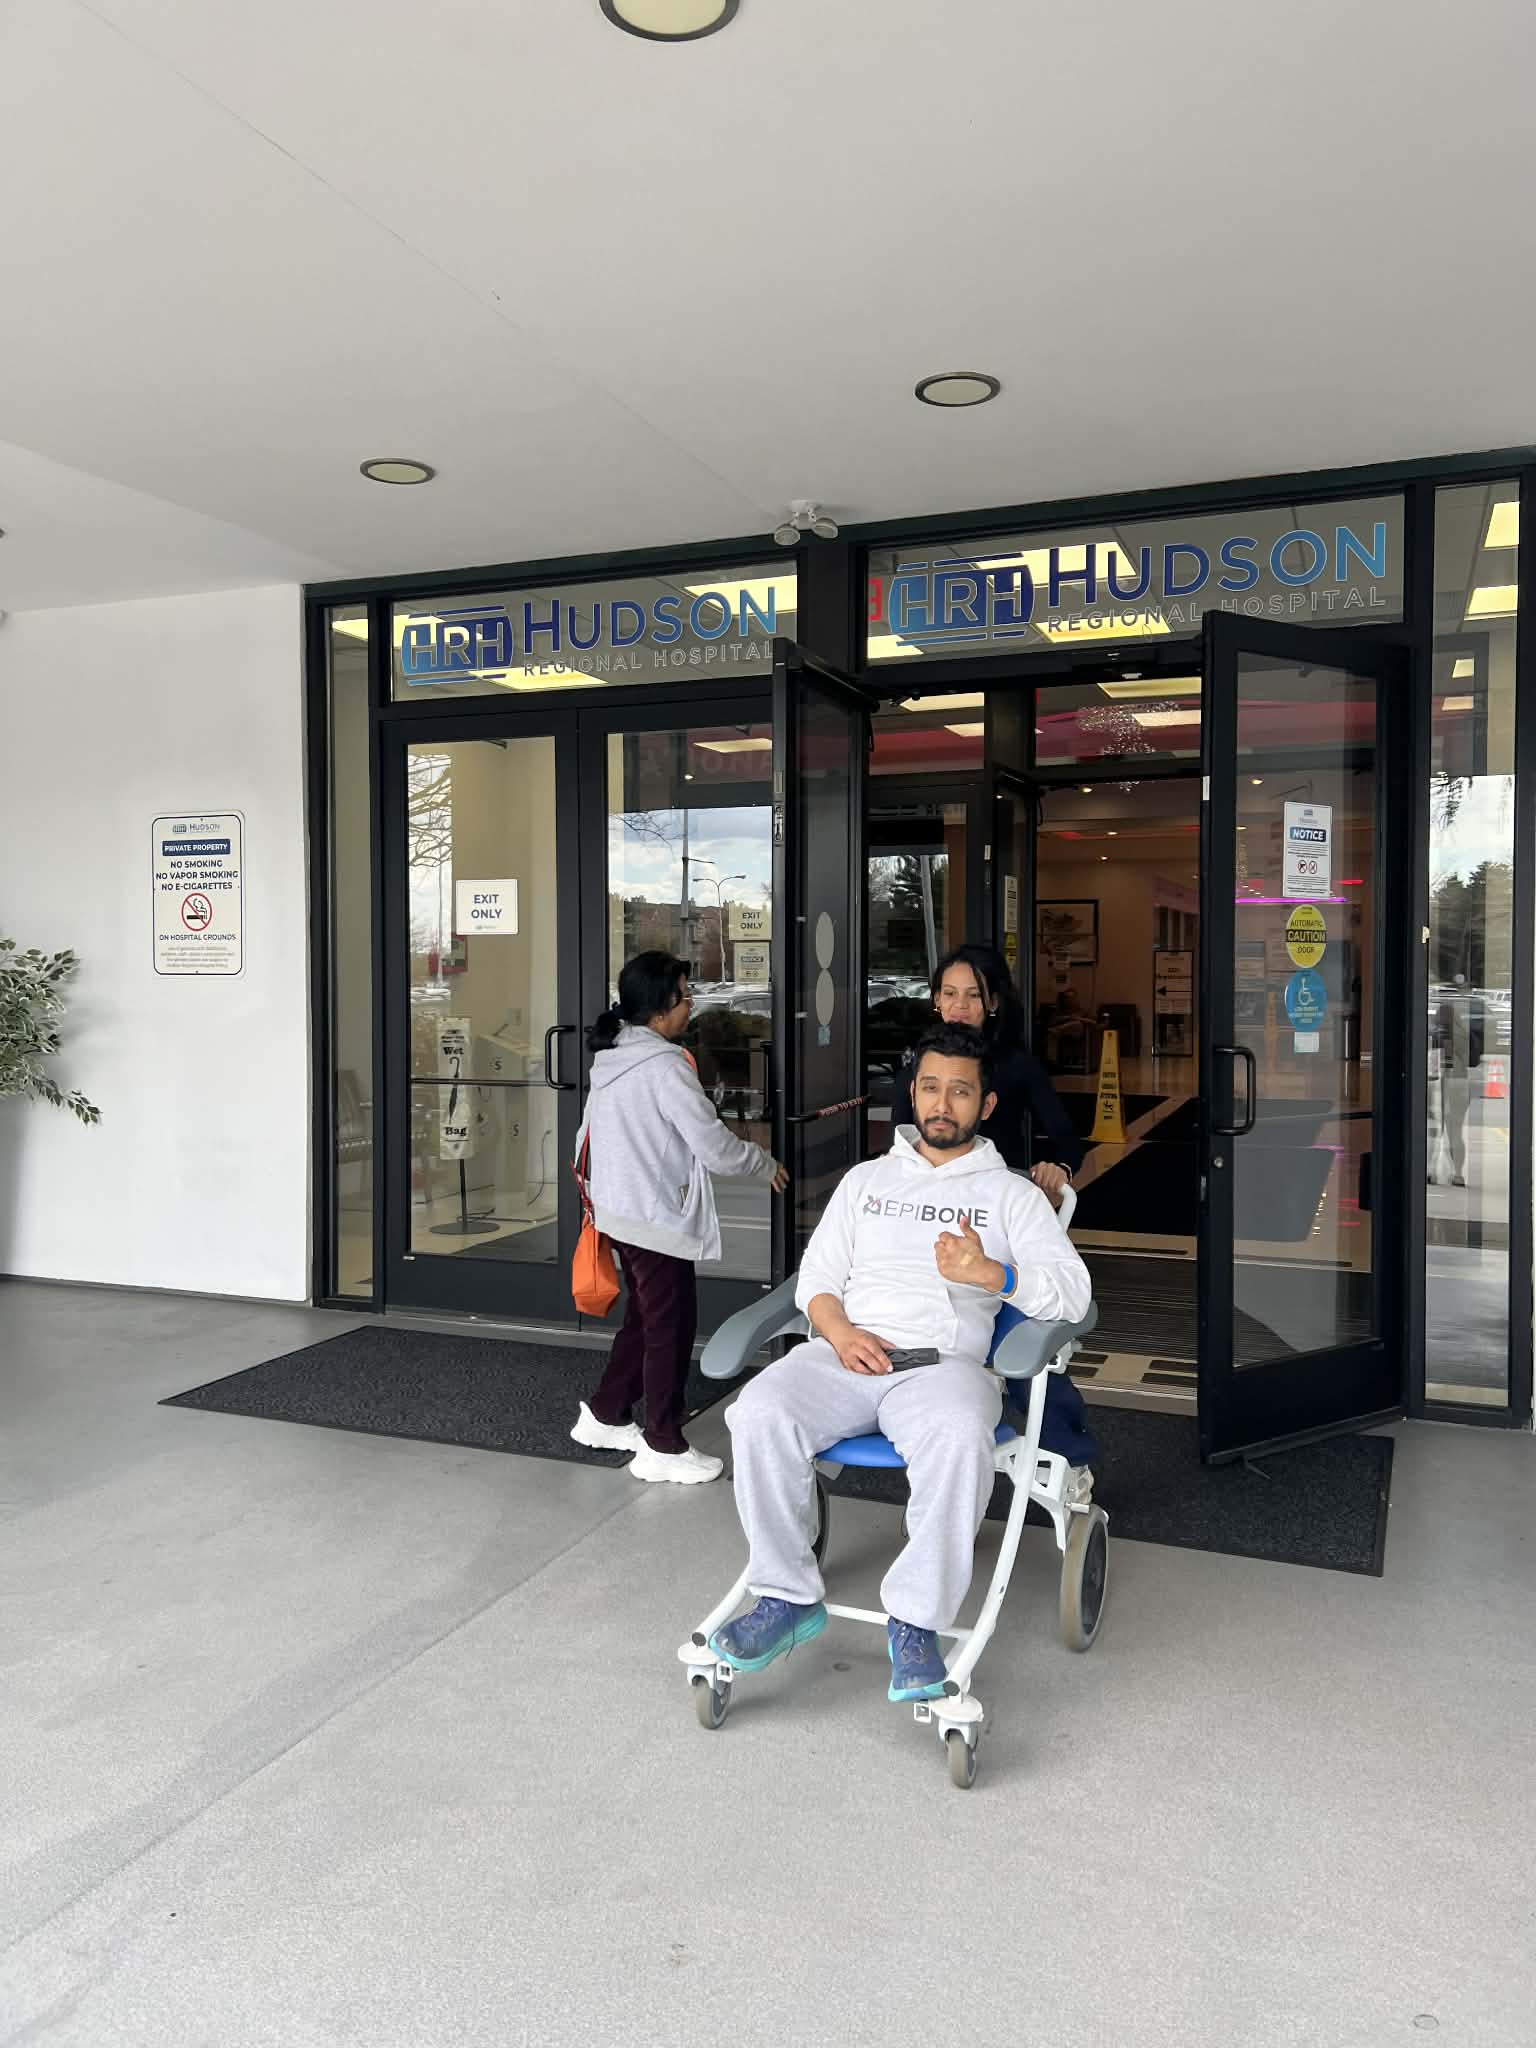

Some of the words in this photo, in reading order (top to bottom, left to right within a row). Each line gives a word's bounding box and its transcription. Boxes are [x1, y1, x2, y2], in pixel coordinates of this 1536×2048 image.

[1047, 521, 1387, 608] HUDSON
[1047, 603, 1202, 633] REGIONAL
[1221, 586, 1386, 617] HOSPITAL
[523, 586, 778, 656] HUDSON
[524, 651, 643, 677] REGIONAL
[654, 639, 774, 668] HOSPITAL
[1292, 828, 1324, 840] NOTICE
[164, 844, 192, 852] PRIVATE
[193, 843, 228, 852] PROPERTY
[170, 861, 183, 869] NO
[184, 860, 223, 868] SMOKING
[156, 872, 168, 880] NO
[170, 872, 198, 880] VAPOR
[199, 871, 239, 879] SMOKING
[161, 883, 174, 891] NO
[175, 882, 233, 891] E-CIGARETTES
[473, 894, 500, 904] EXIT
[471, 908, 503, 919] ONLY
[742, 911, 761, 919] EXIT
[740, 922, 763, 930] ONLY
[203, 933, 237, 941] GROUNDS
[1287, 930, 1326, 942] CAUTION
[443, 1046, 465, 1055] Wet
[445, 1126, 467, 1137] Bag
[884, 1199, 989, 1228] EPIBONE
